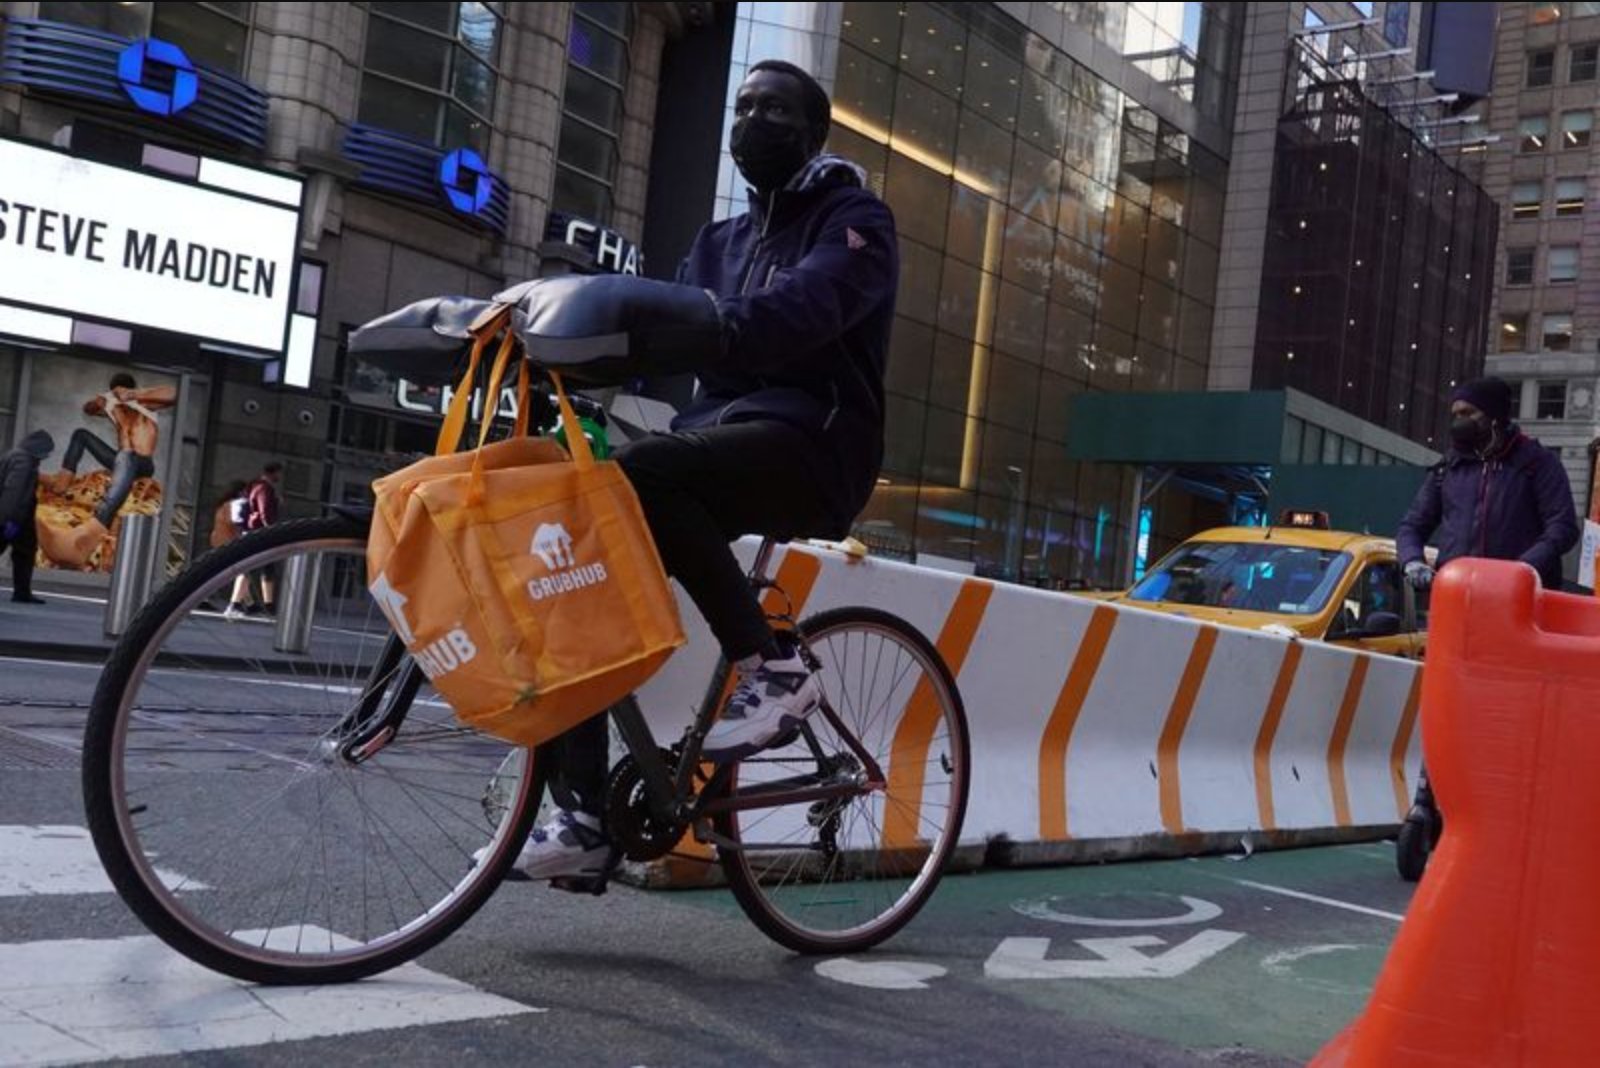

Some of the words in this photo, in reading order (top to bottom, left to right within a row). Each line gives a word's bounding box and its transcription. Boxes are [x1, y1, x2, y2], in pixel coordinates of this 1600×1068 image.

[0, 198, 107, 263] STEVE
[123, 227, 276, 298] MADDEN
[565, 220, 644, 278] CHA
[527, 562, 608, 600] GRUBHUB
